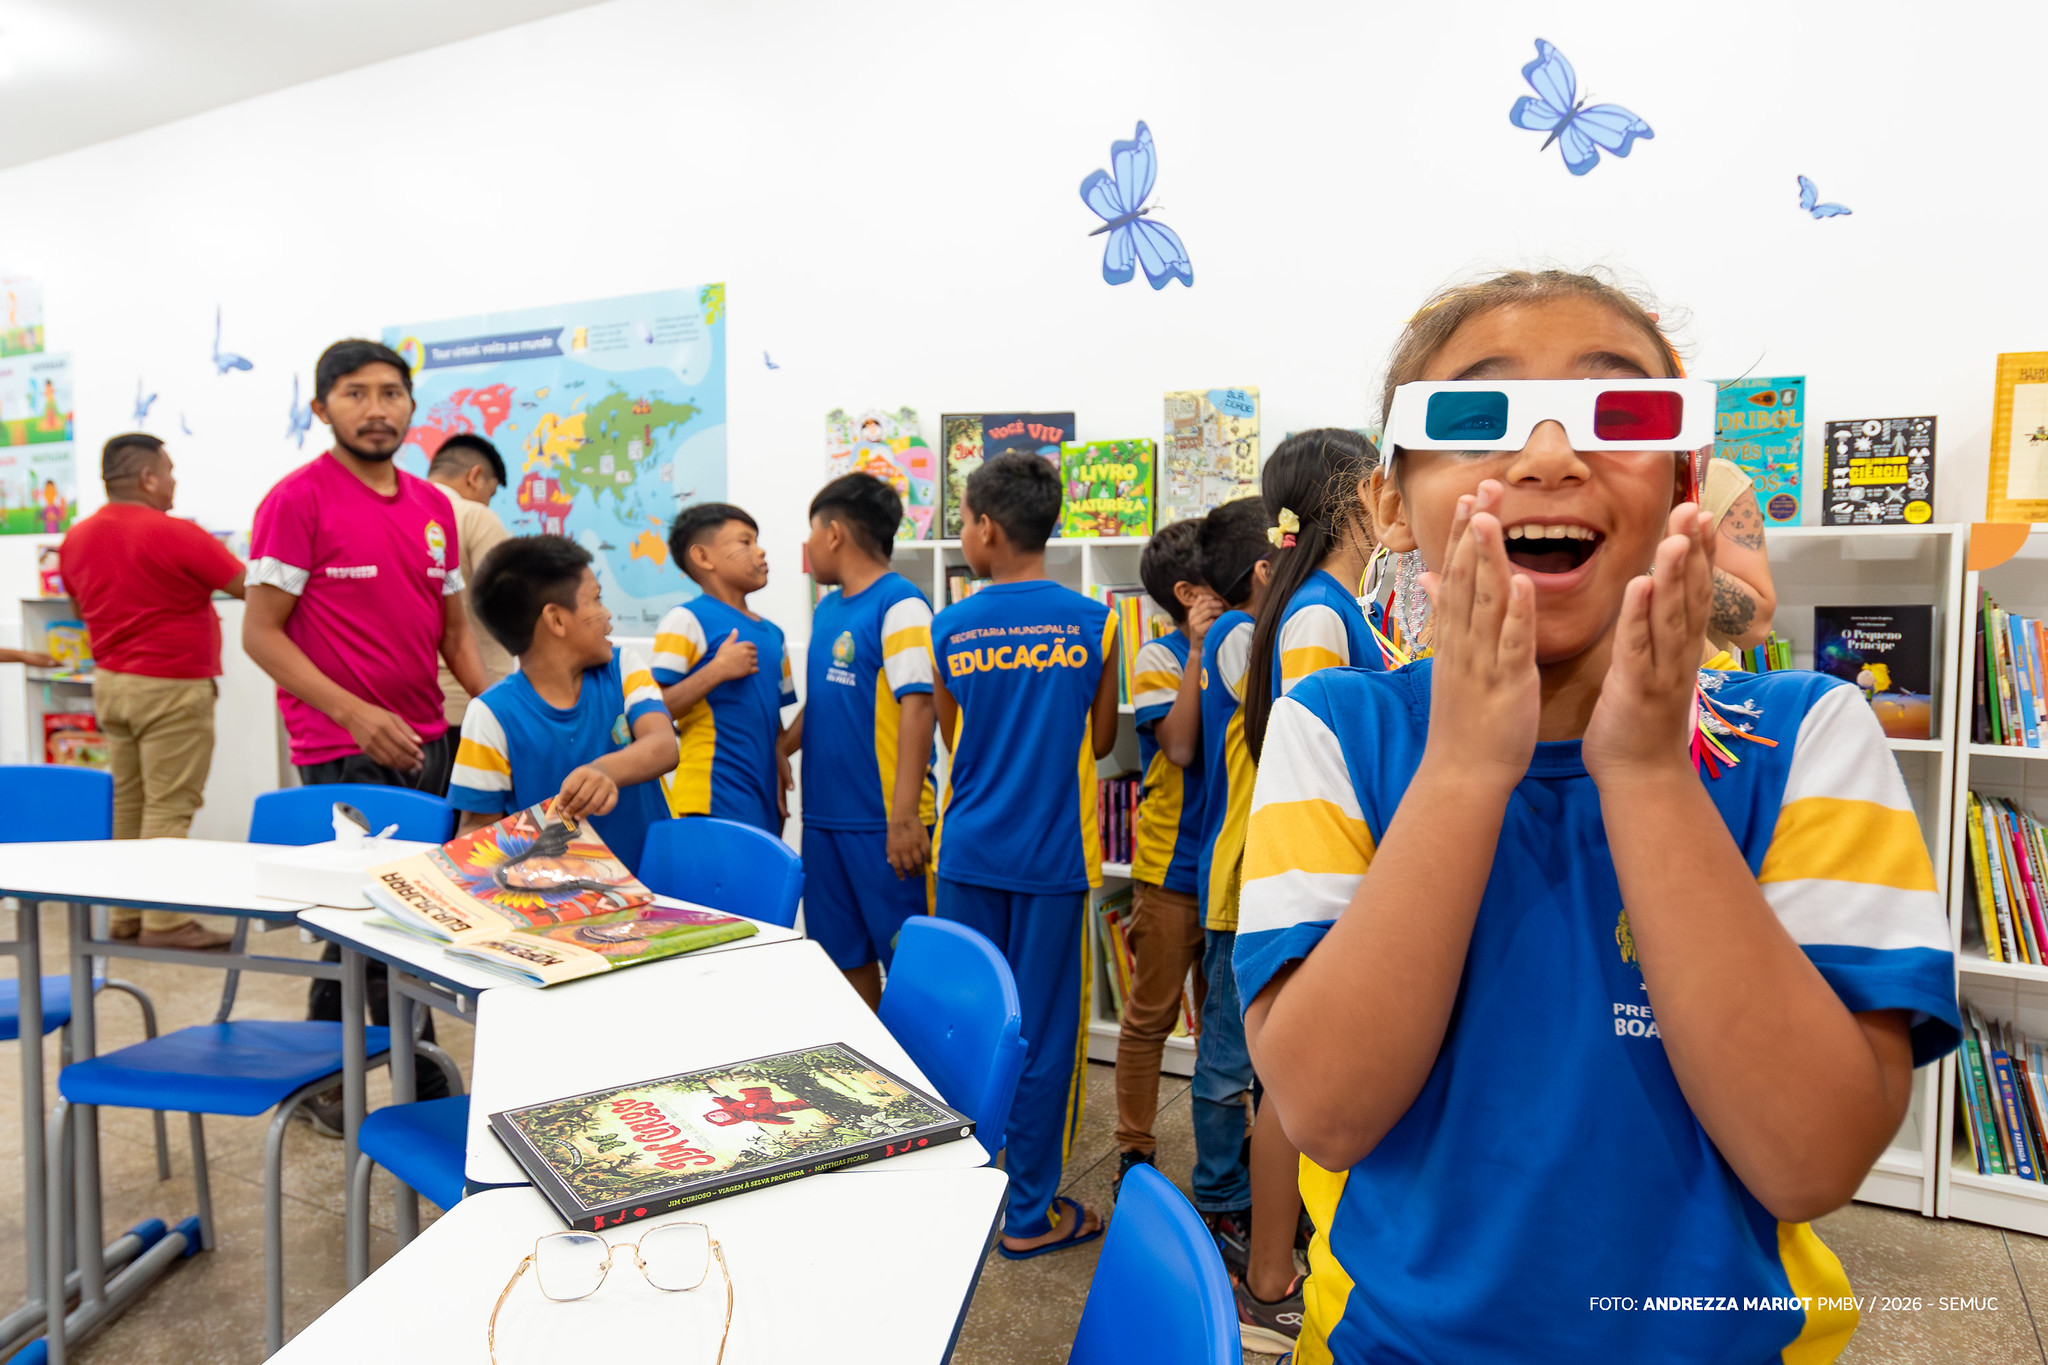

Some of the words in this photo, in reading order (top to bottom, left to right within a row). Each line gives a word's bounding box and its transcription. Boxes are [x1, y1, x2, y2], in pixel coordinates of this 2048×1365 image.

[1717, 409, 1803, 431] DRIBOL
[988, 419, 1025, 441] VOCÊ
[1027, 423, 1064, 443] VIU
[1711, 442, 1762, 461] AVÉS
[1079, 463, 1139, 483] LIVRO
[1849, 461, 1908, 479] CIÊNCIA
[1069, 496, 1147, 514] NATUREZA
[950, 626, 1007, 644] SECRETARIA
[1008, 624, 1065, 636] MUNICIPAL
[1067, 624, 1080, 635] DE
[1841, 629, 1852, 639] O
[1853, 629, 1903, 642] Pequeno
[947, 637, 1088, 677] EDUCAÇÃO
[380, 871, 473, 932] GUAJAJARA
[1613, 1002, 1652, 1019] PRE
[1614, 1018, 1662, 1039] BOA
[667, 1198, 681, 1208] JIM
[681, 1190, 712, 1206] CURIOSO
[717, 1183, 744, 1196] VIAGEM
[744, 1181, 750, 1190] À
[750, 1177, 770, 1188] SELVA
[770, 1169, 805, 1184] PROFUNDA
[814, 1158, 846, 1173] MATTHIAS
[846, 1152, 870, 1166] PICARD
